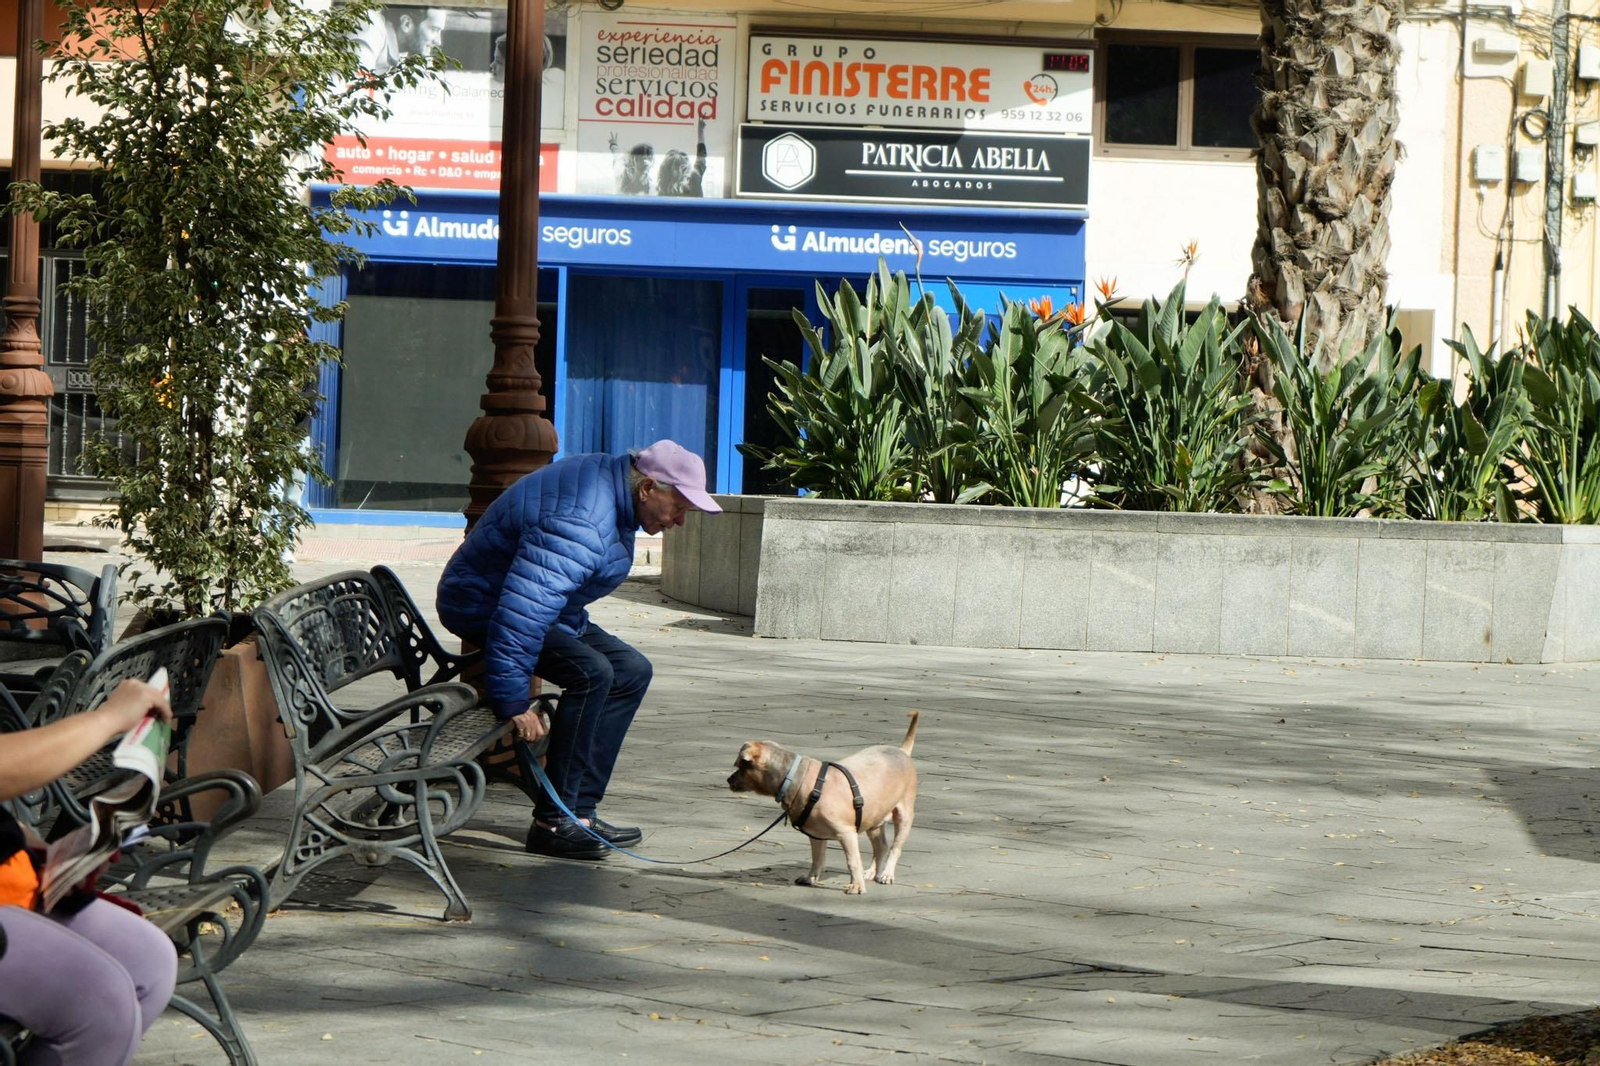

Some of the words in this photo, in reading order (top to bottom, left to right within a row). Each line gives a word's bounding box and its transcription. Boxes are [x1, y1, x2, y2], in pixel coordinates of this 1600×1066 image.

[597, 28, 721, 45] experiencia
[596, 42, 718, 67] seriedad
[762, 43, 876, 60] GRUPO
[596, 63, 718, 80] profesionalidad
[760, 58, 991, 103] FINISTERRE
[595, 77, 718, 99] servicios
[595, 93, 717, 120] calidad
[760, 99, 856, 116] SERVICIOS
[866, 104, 986, 120] FUNERARIOS
[1001, 109, 1025, 120] 959
[1030, 110, 1042, 121] 12
[1046, 111, 1061, 121] 32
[1066, 112, 1083, 122] 06
[336, 146, 371, 160] auto
[388, 146, 434, 164] hogar
[451, 149, 495, 164] salud
[861, 142, 963, 172] PATRICIA
[971, 146, 1050, 171] ABELLA
[352, 164, 402, 176] comercio
[912, 180, 993, 189] ABOGADOS
[542, 225, 632, 248] seguros
[928, 239, 1017, 261] seguros
